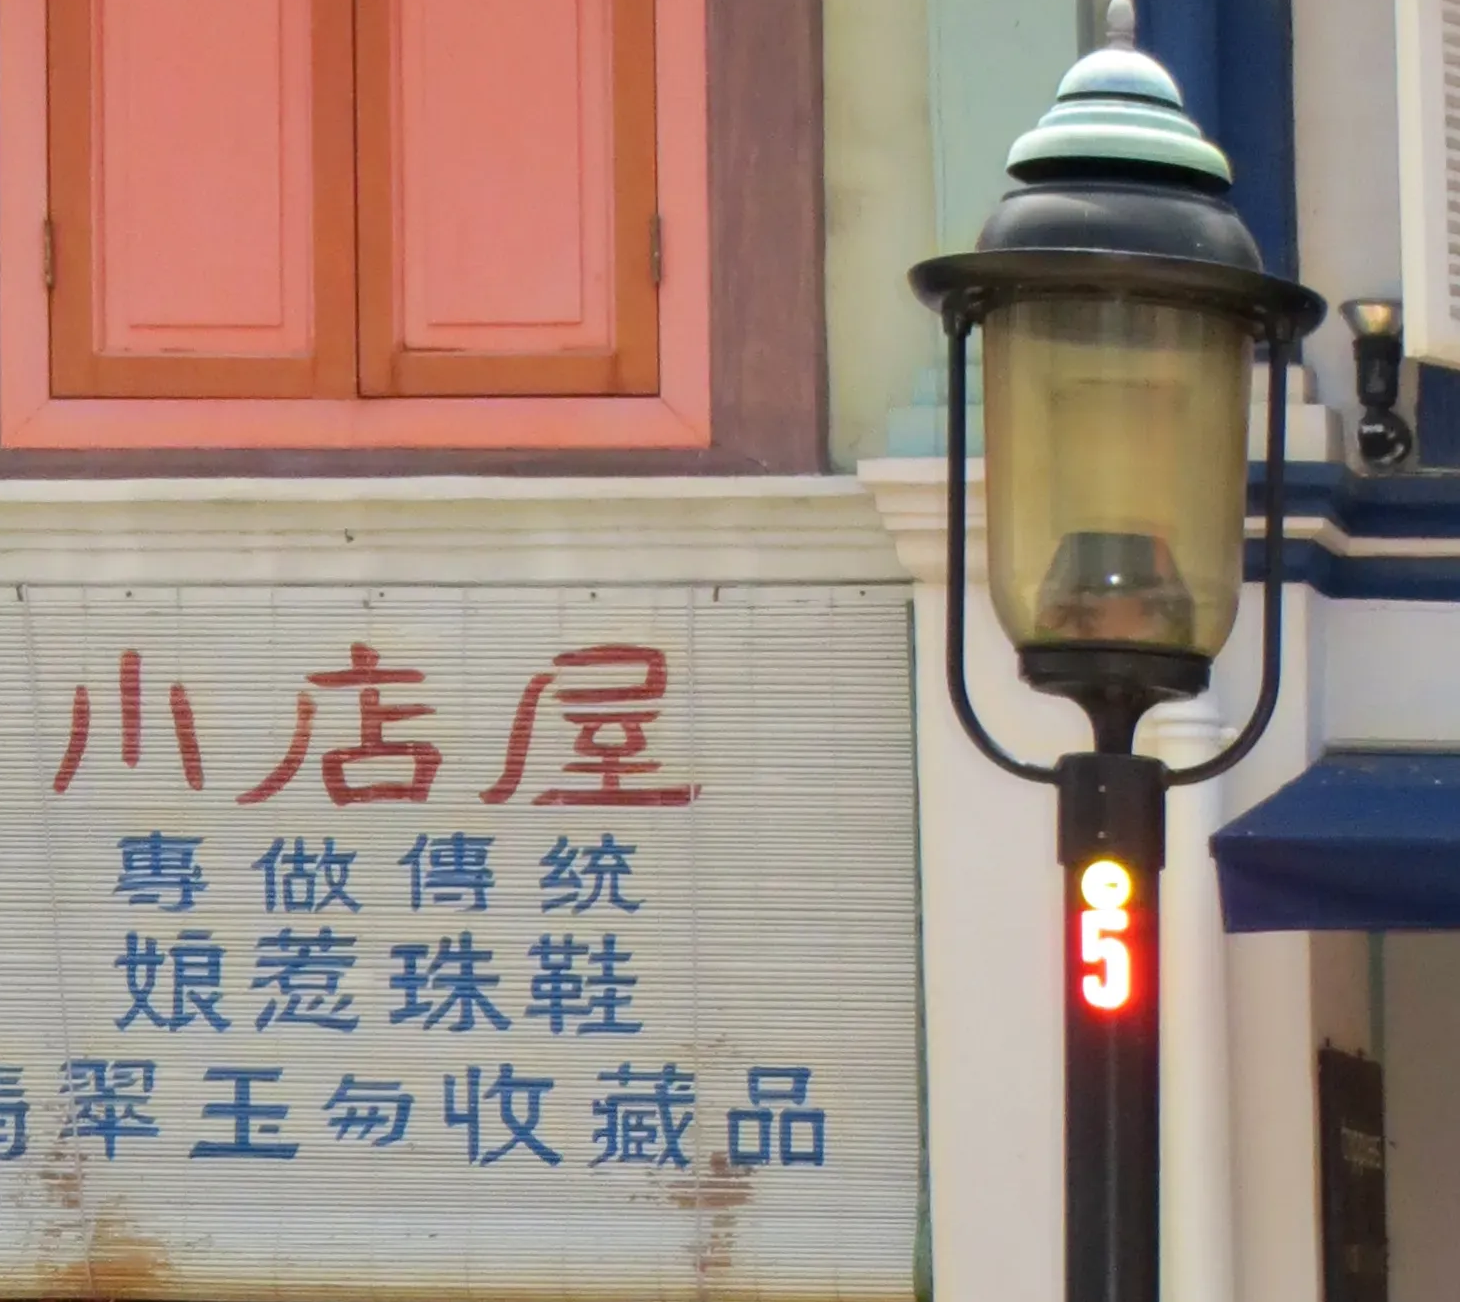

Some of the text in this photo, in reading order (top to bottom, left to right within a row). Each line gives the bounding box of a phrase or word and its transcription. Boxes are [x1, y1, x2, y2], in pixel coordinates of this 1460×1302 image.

[52, 644, 701, 806] 小店屋
[114, 925, 646, 1037] 娘惹珠鞋
